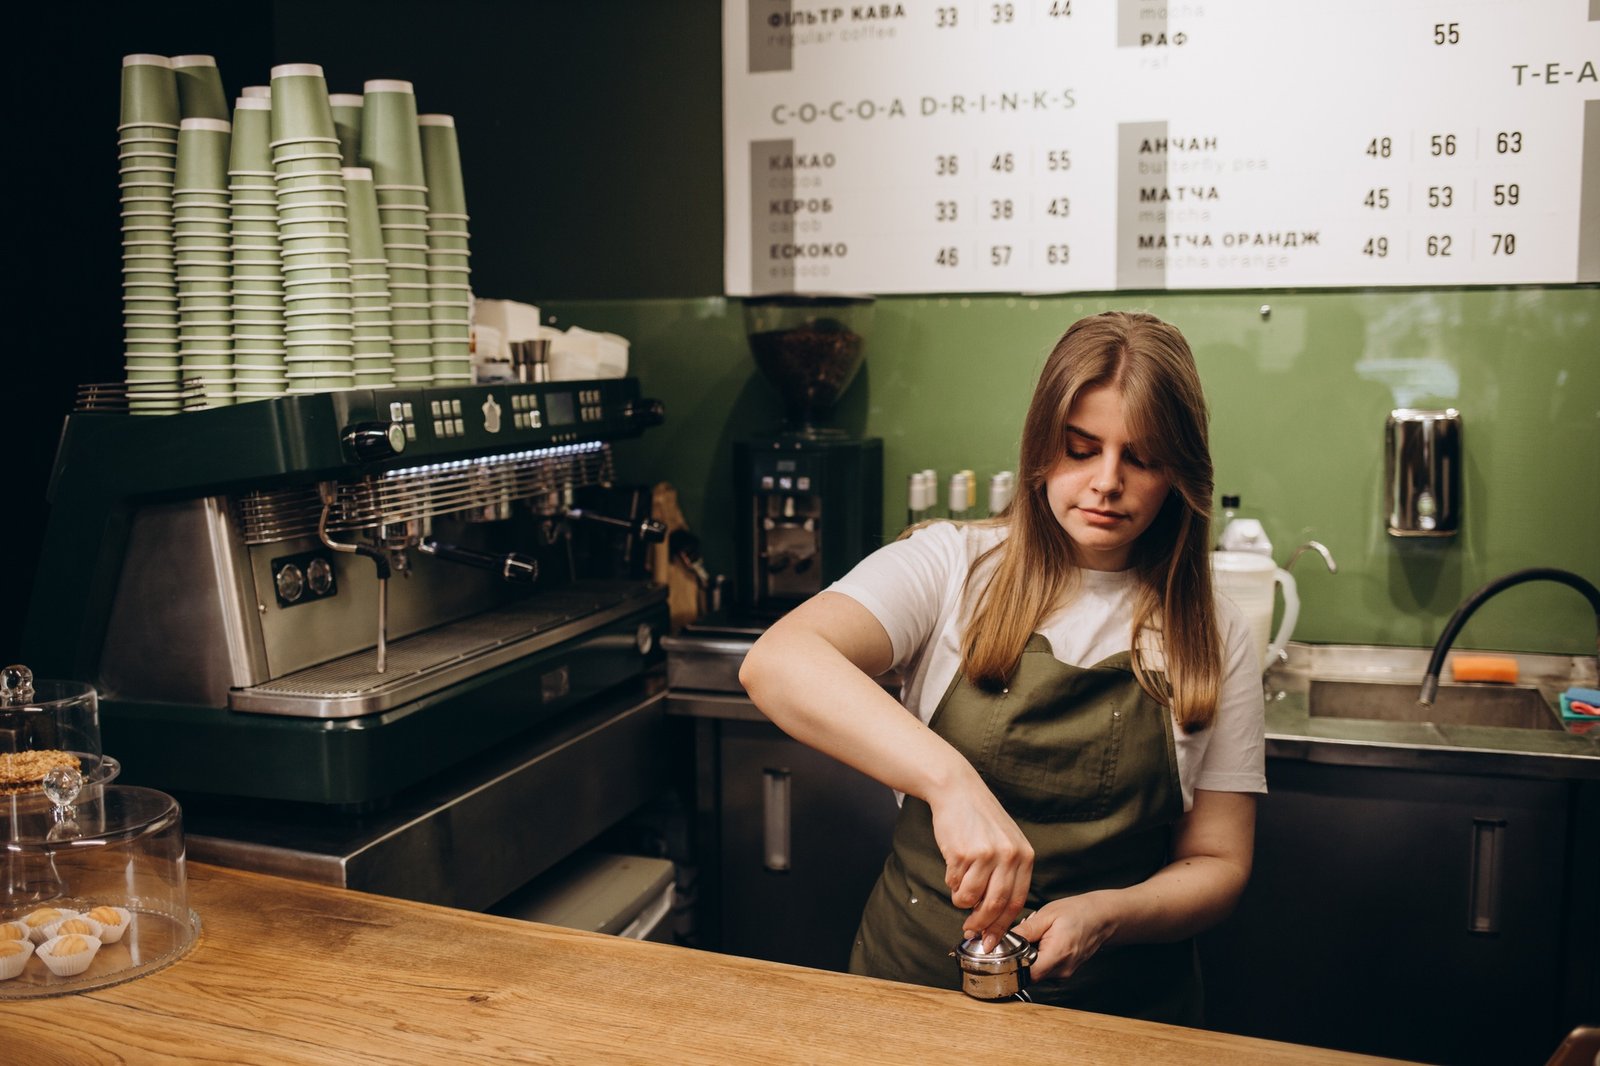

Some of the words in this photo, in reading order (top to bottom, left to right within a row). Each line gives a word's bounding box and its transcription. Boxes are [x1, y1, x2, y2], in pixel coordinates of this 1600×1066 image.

[767, 8, 844, 28] ФІЛЬТР
[852, 4, 905, 21] КАВА
[936, 8, 958, 28] 33
[991, 3, 1014, 24] 39
[1049, 0, 1072, 17] 44
[840, 26, 897, 41] coffee
[1140, 32, 1187, 47] РАФ
[1434, 22, 1460, 45] 55
[771, 99, 906, 125] C-O-C-O-A
[921, 89, 1076, 117] D-R-I-N-K-S
[1139, 137, 1217, 154] АНЧАН
[1366, 137, 1392, 158] 48
[1431, 134, 1457, 157] 56
[1497, 131, 1523, 154] 63
[769, 153, 836, 170] КАКАО
[936, 155, 958, 176] 36
[991, 152, 1014, 173] 46
[1048, 150, 1071, 171] 55
[1139, 186, 1219, 203] МАТЧА
[1364, 188, 1389, 209] 45
[1428, 186, 1453, 208] 53
[1493, 184, 1520, 206] 59
[769, 198, 833, 215] КЕРОБ
[936, 201, 958, 222] 33
[991, 199, 1014, 220] 38
[1047, 197, 1070, 218] 43
[769, 242, 848, 260] ЕСКОКО
[936, 247, 959, 267] 46
[991, 246, 1013, 266] 57
[1047, 244, 1070, 265] 63
[1137, 233, 1213, 250] МАТЧА
[1222, 231, 1320, 249] ОРАНДЖ
[1363, 236, 1388, 258] 49
[1427, 235, 1453, 257] 62
[1491, 233, 1516, 255] 70
